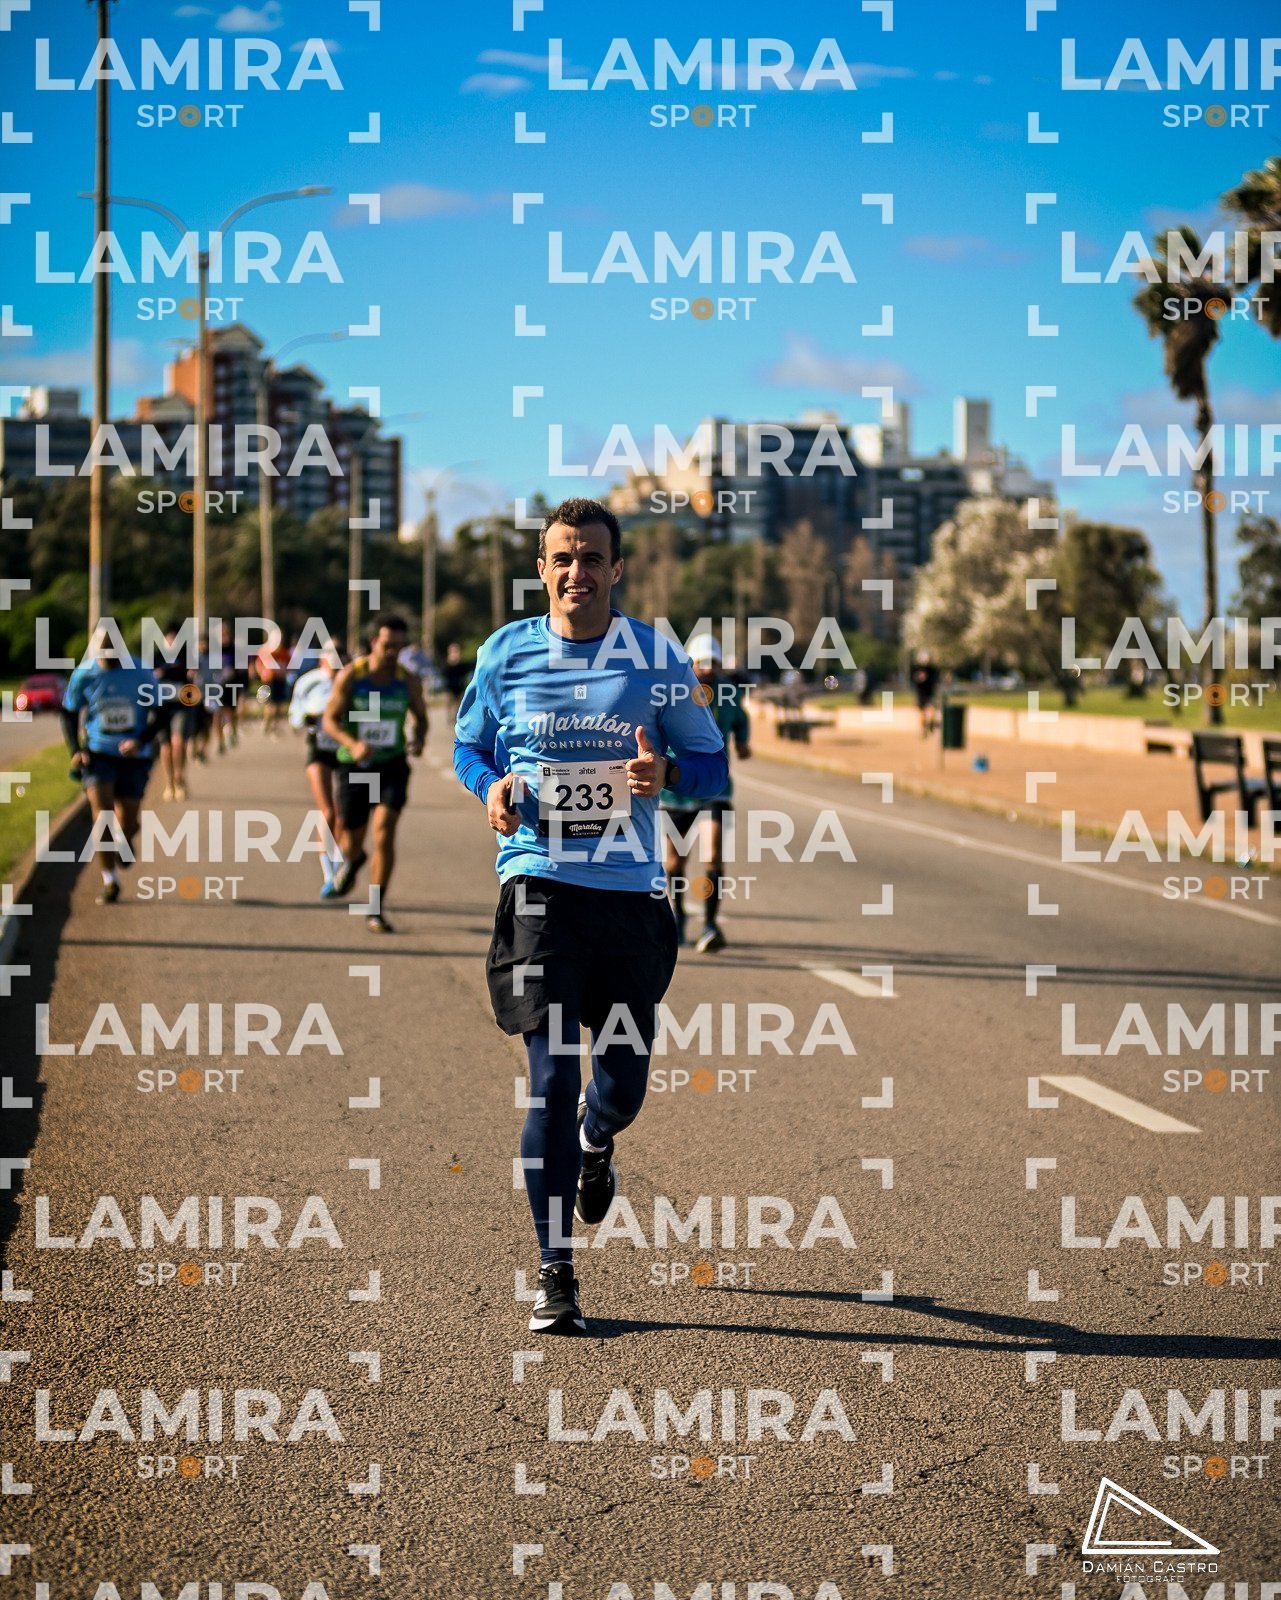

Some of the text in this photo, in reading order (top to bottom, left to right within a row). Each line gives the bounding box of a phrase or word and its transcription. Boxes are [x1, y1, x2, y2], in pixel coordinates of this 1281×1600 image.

[528, 711, 632, 738] Maratón
[539, 740, 623, 750] MONTEVIDEO
[554, 783, 614, 811] 233
